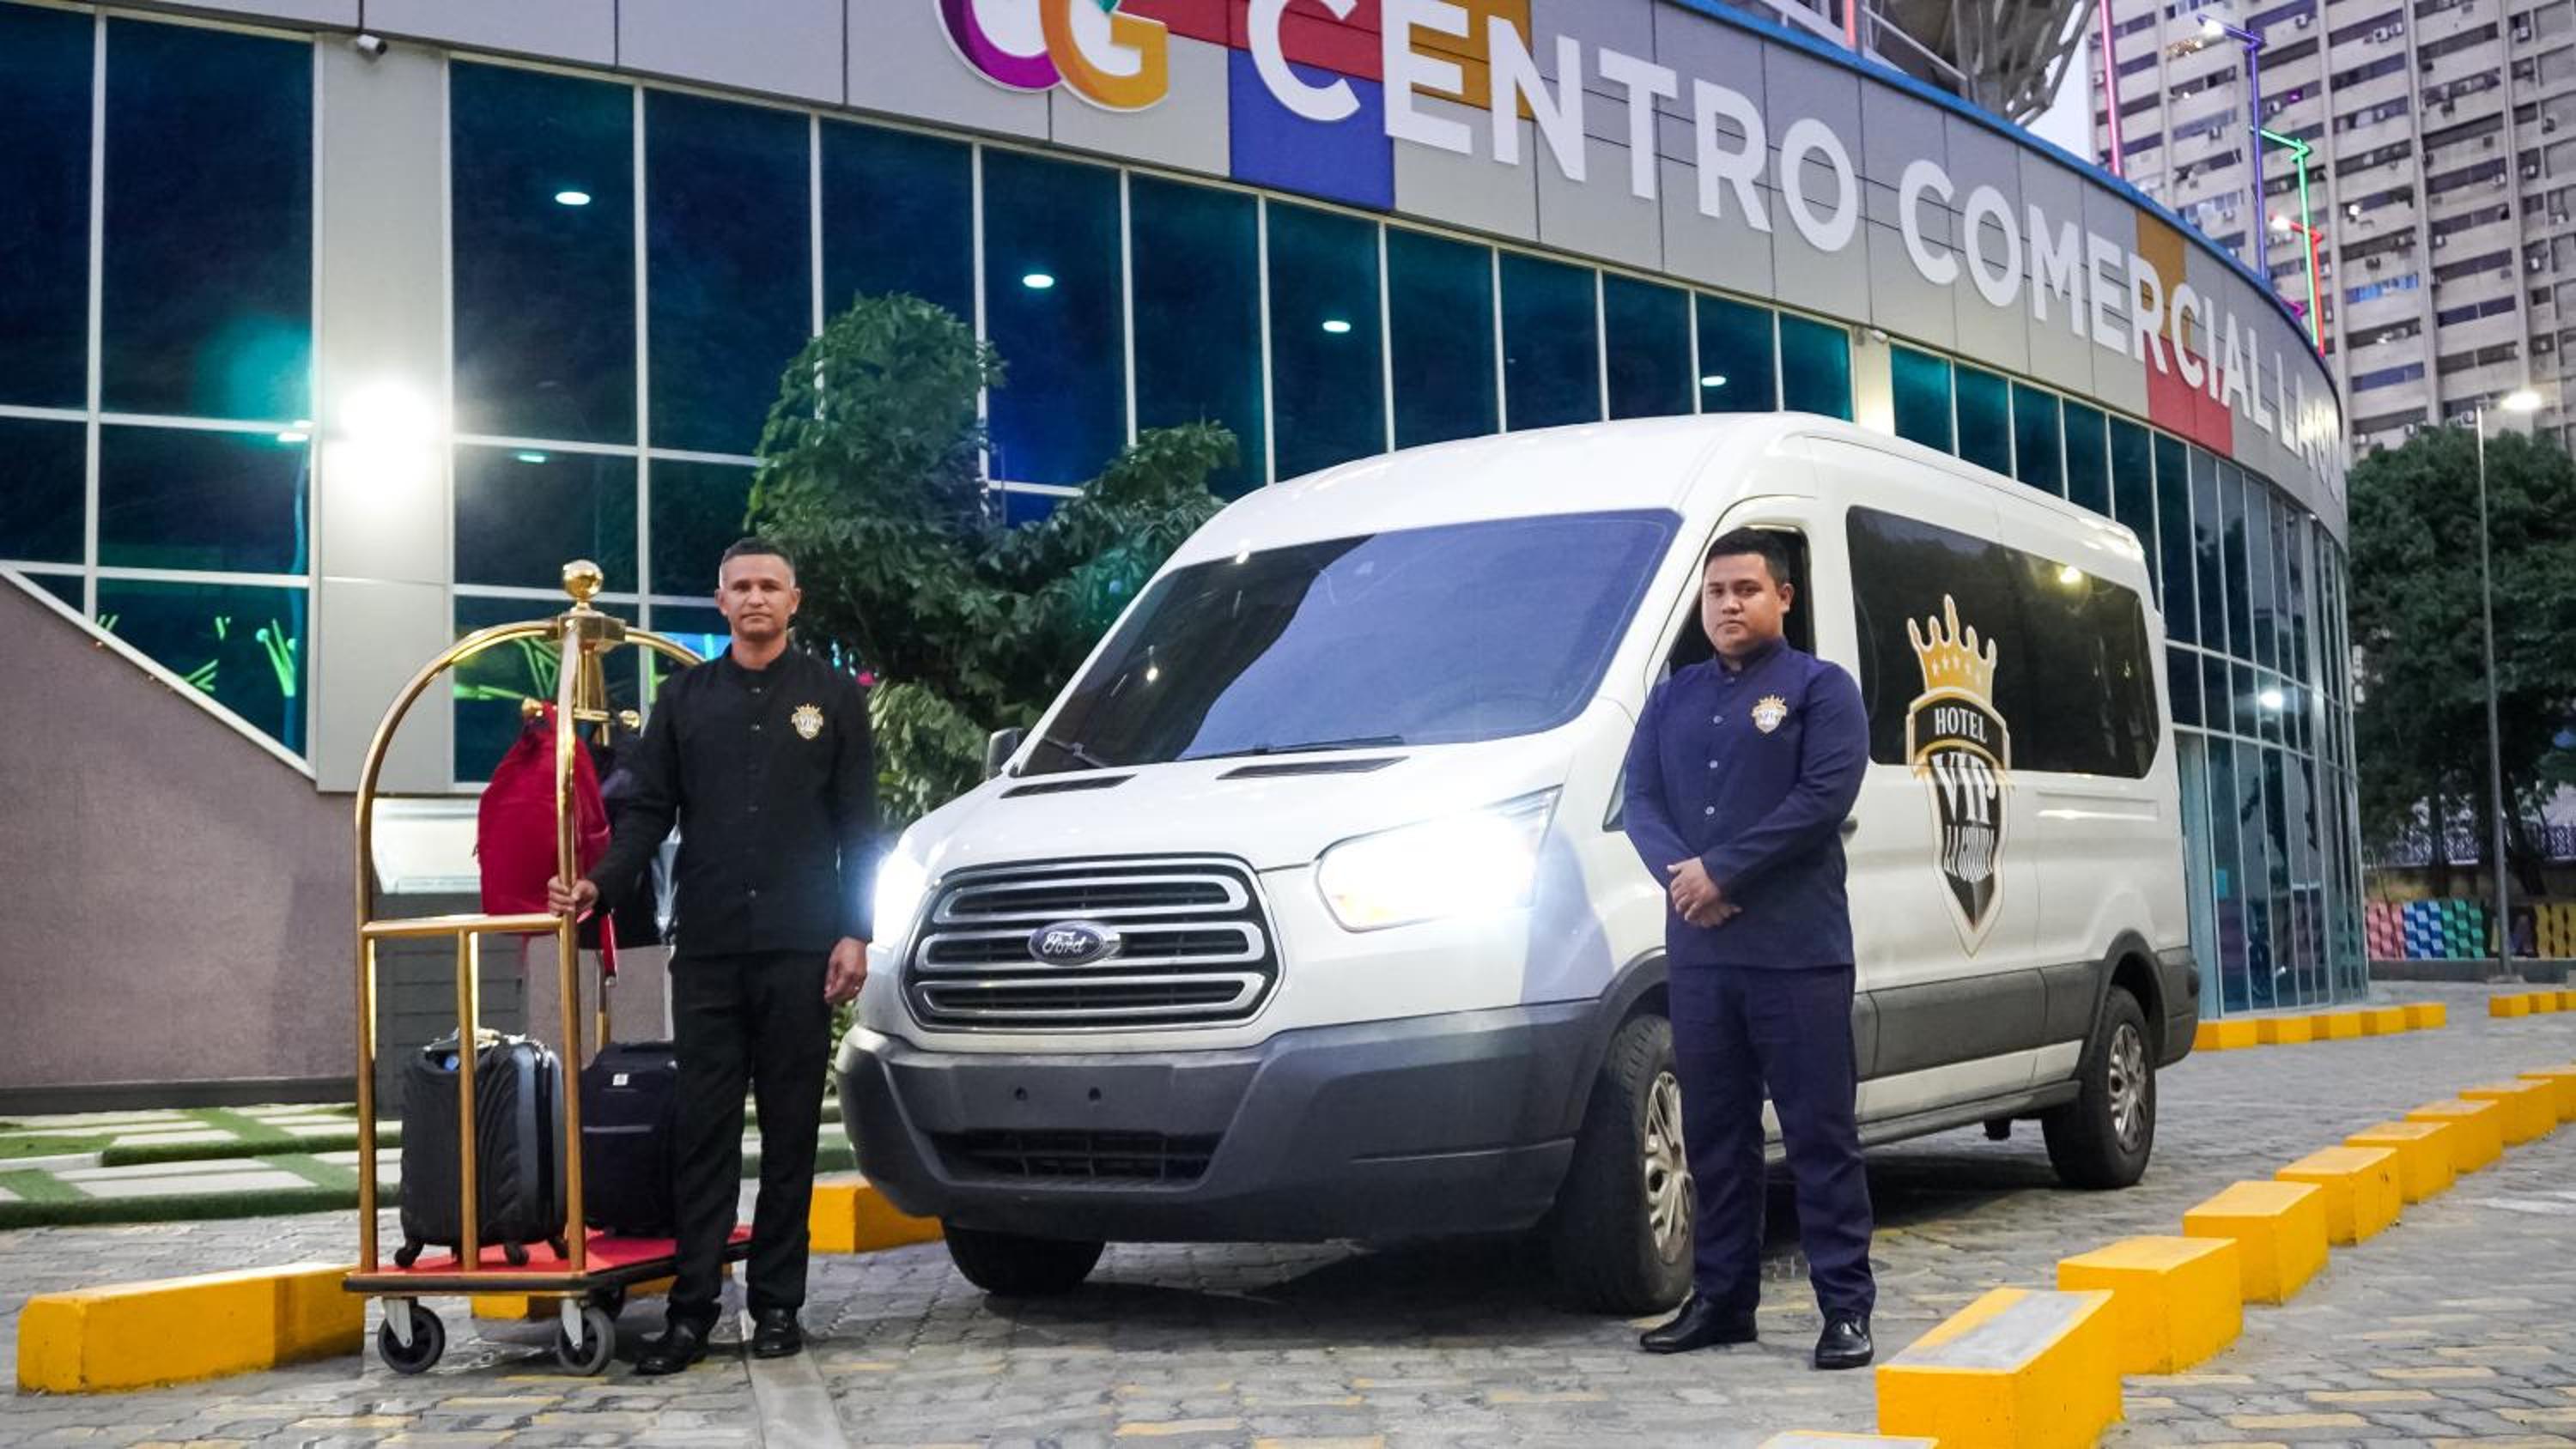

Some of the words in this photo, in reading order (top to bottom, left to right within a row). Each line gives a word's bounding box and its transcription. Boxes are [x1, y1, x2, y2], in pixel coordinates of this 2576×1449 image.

[1248, 0, 1859, 253] CENTRO
[1899, 159, 2272, 433] COMERCIAL
[1934, 706, 1987, 743] HOTEL
[1931, 751, 1996, 824] VIP
[1042, 931, 1086, 955] Ford
